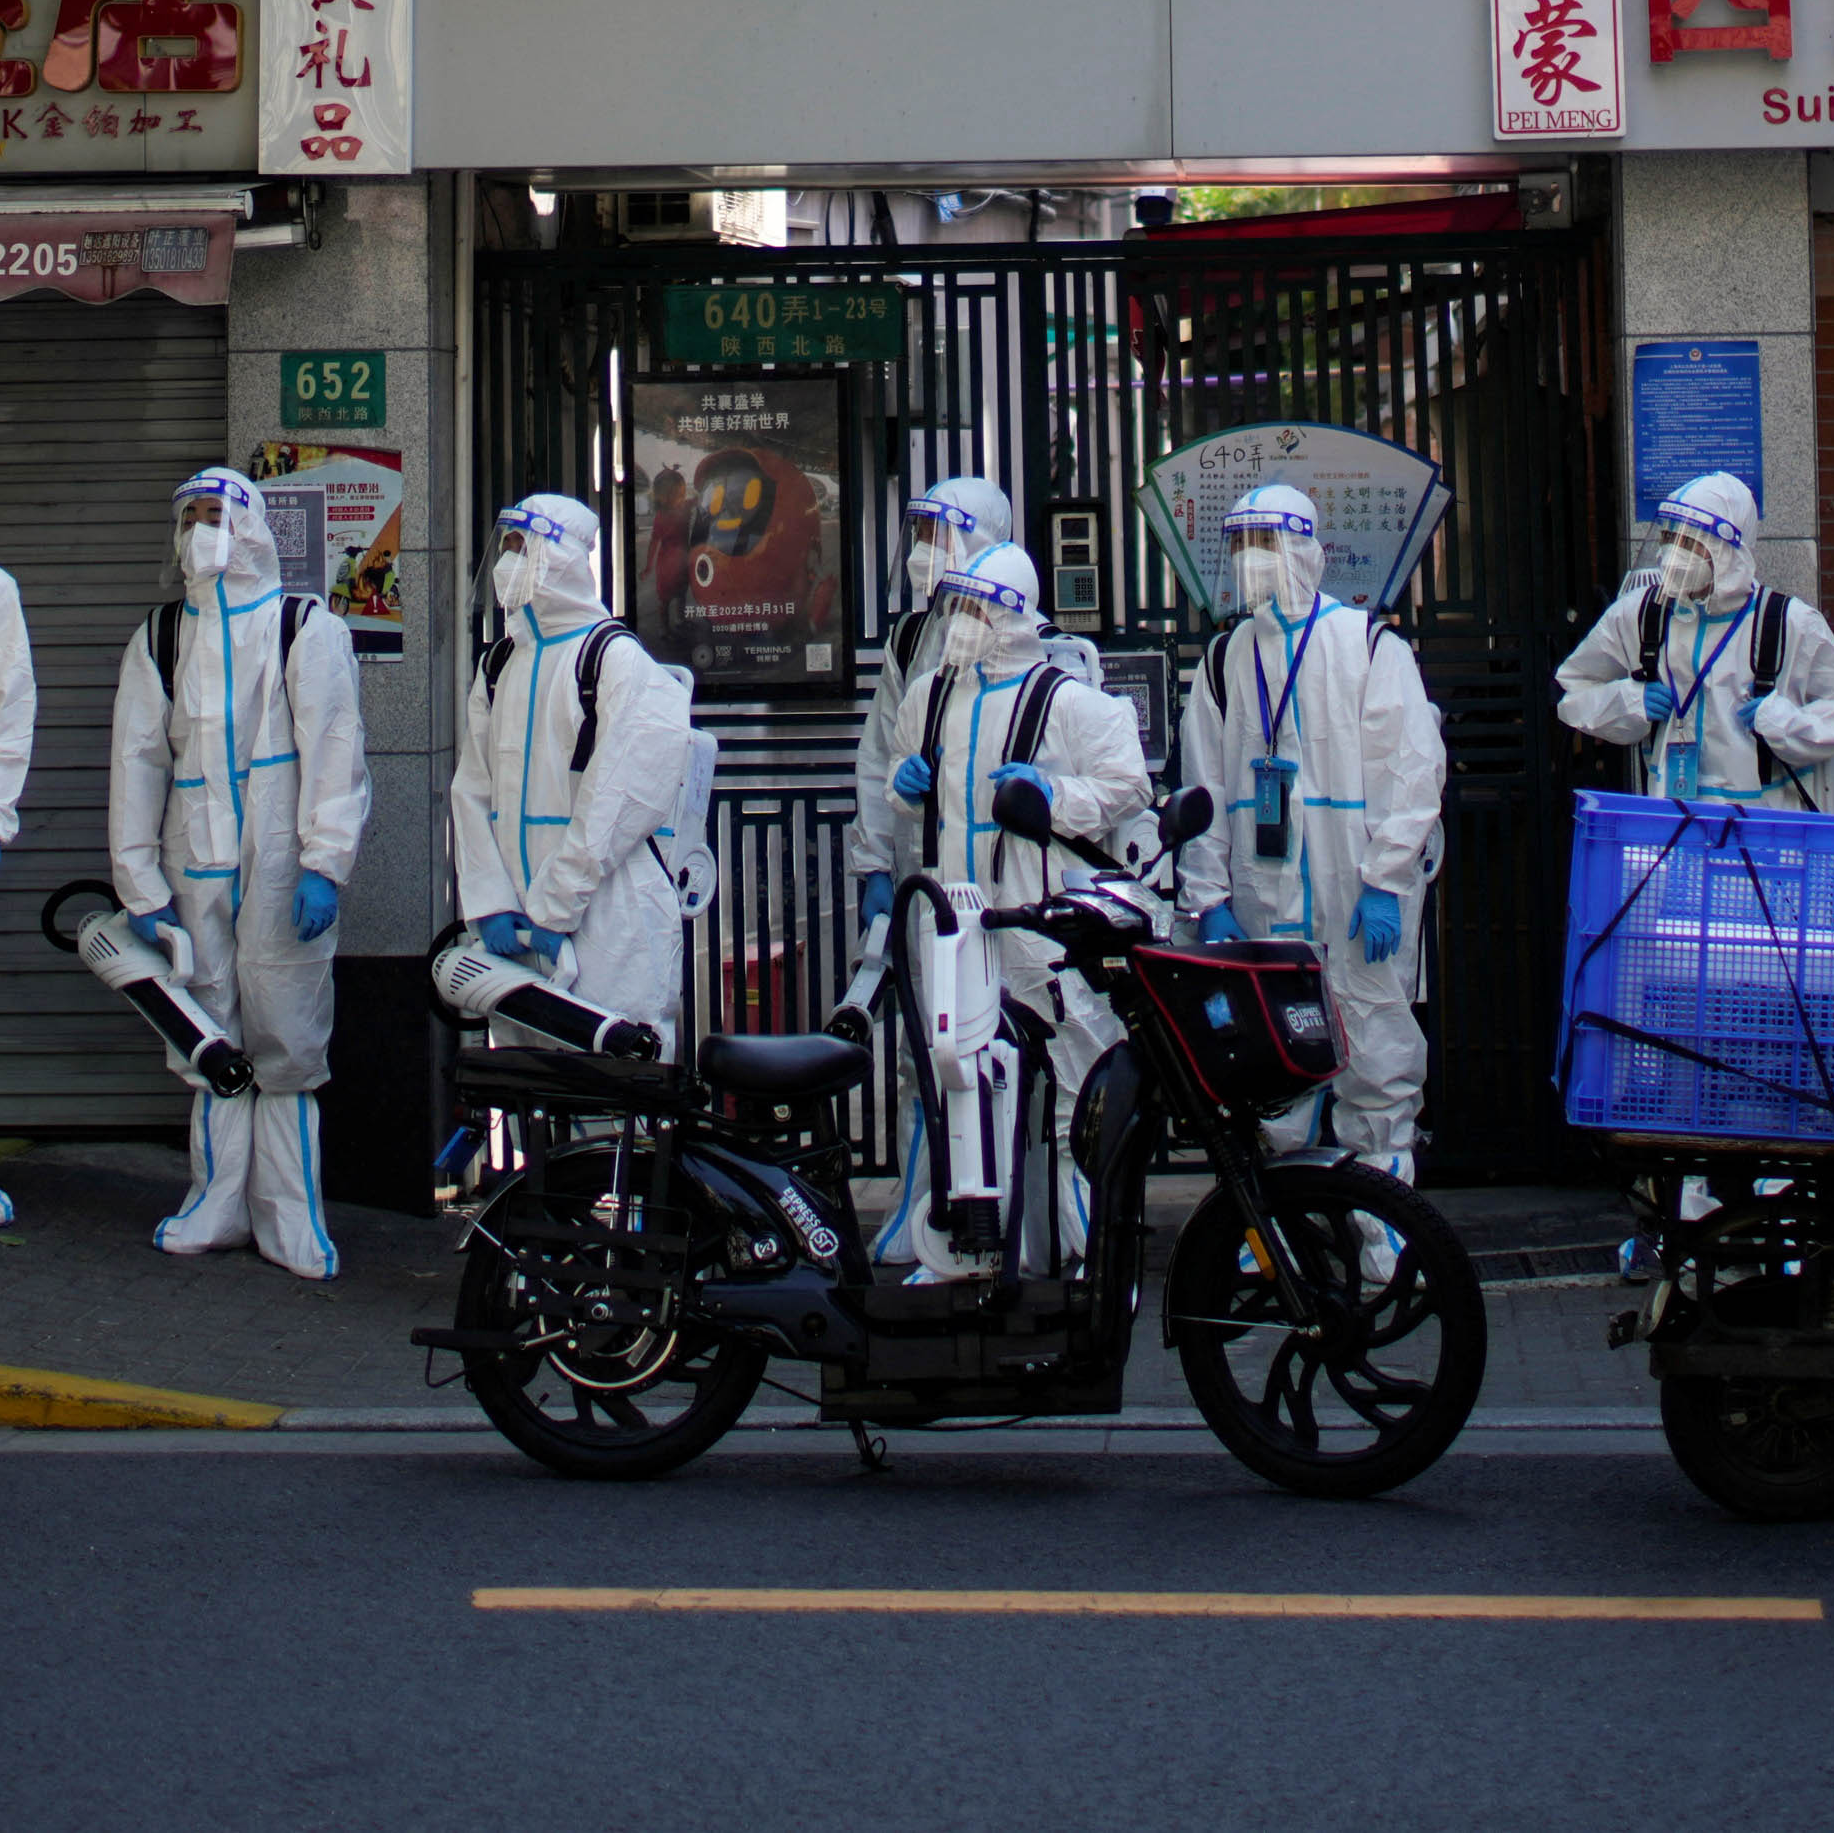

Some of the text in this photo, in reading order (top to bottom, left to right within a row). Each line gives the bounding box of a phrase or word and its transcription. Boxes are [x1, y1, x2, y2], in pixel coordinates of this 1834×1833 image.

[1507, 110, 1613, 132] PEI MENG
[720, 334, 848, 358] 陕西北路
[296, 361, 371, 401] 652
[700, 392, 766, 412] 共襄盛举
[297, 405, 369, 422] 陕西北路
[677, 412, 790, 433] 共创美好新世界
[1199, 444, 1265, 472] 640弄
[1343, 486, 1371, 499] 文明
[782, 1186, 822, 1228] EXPRESS
